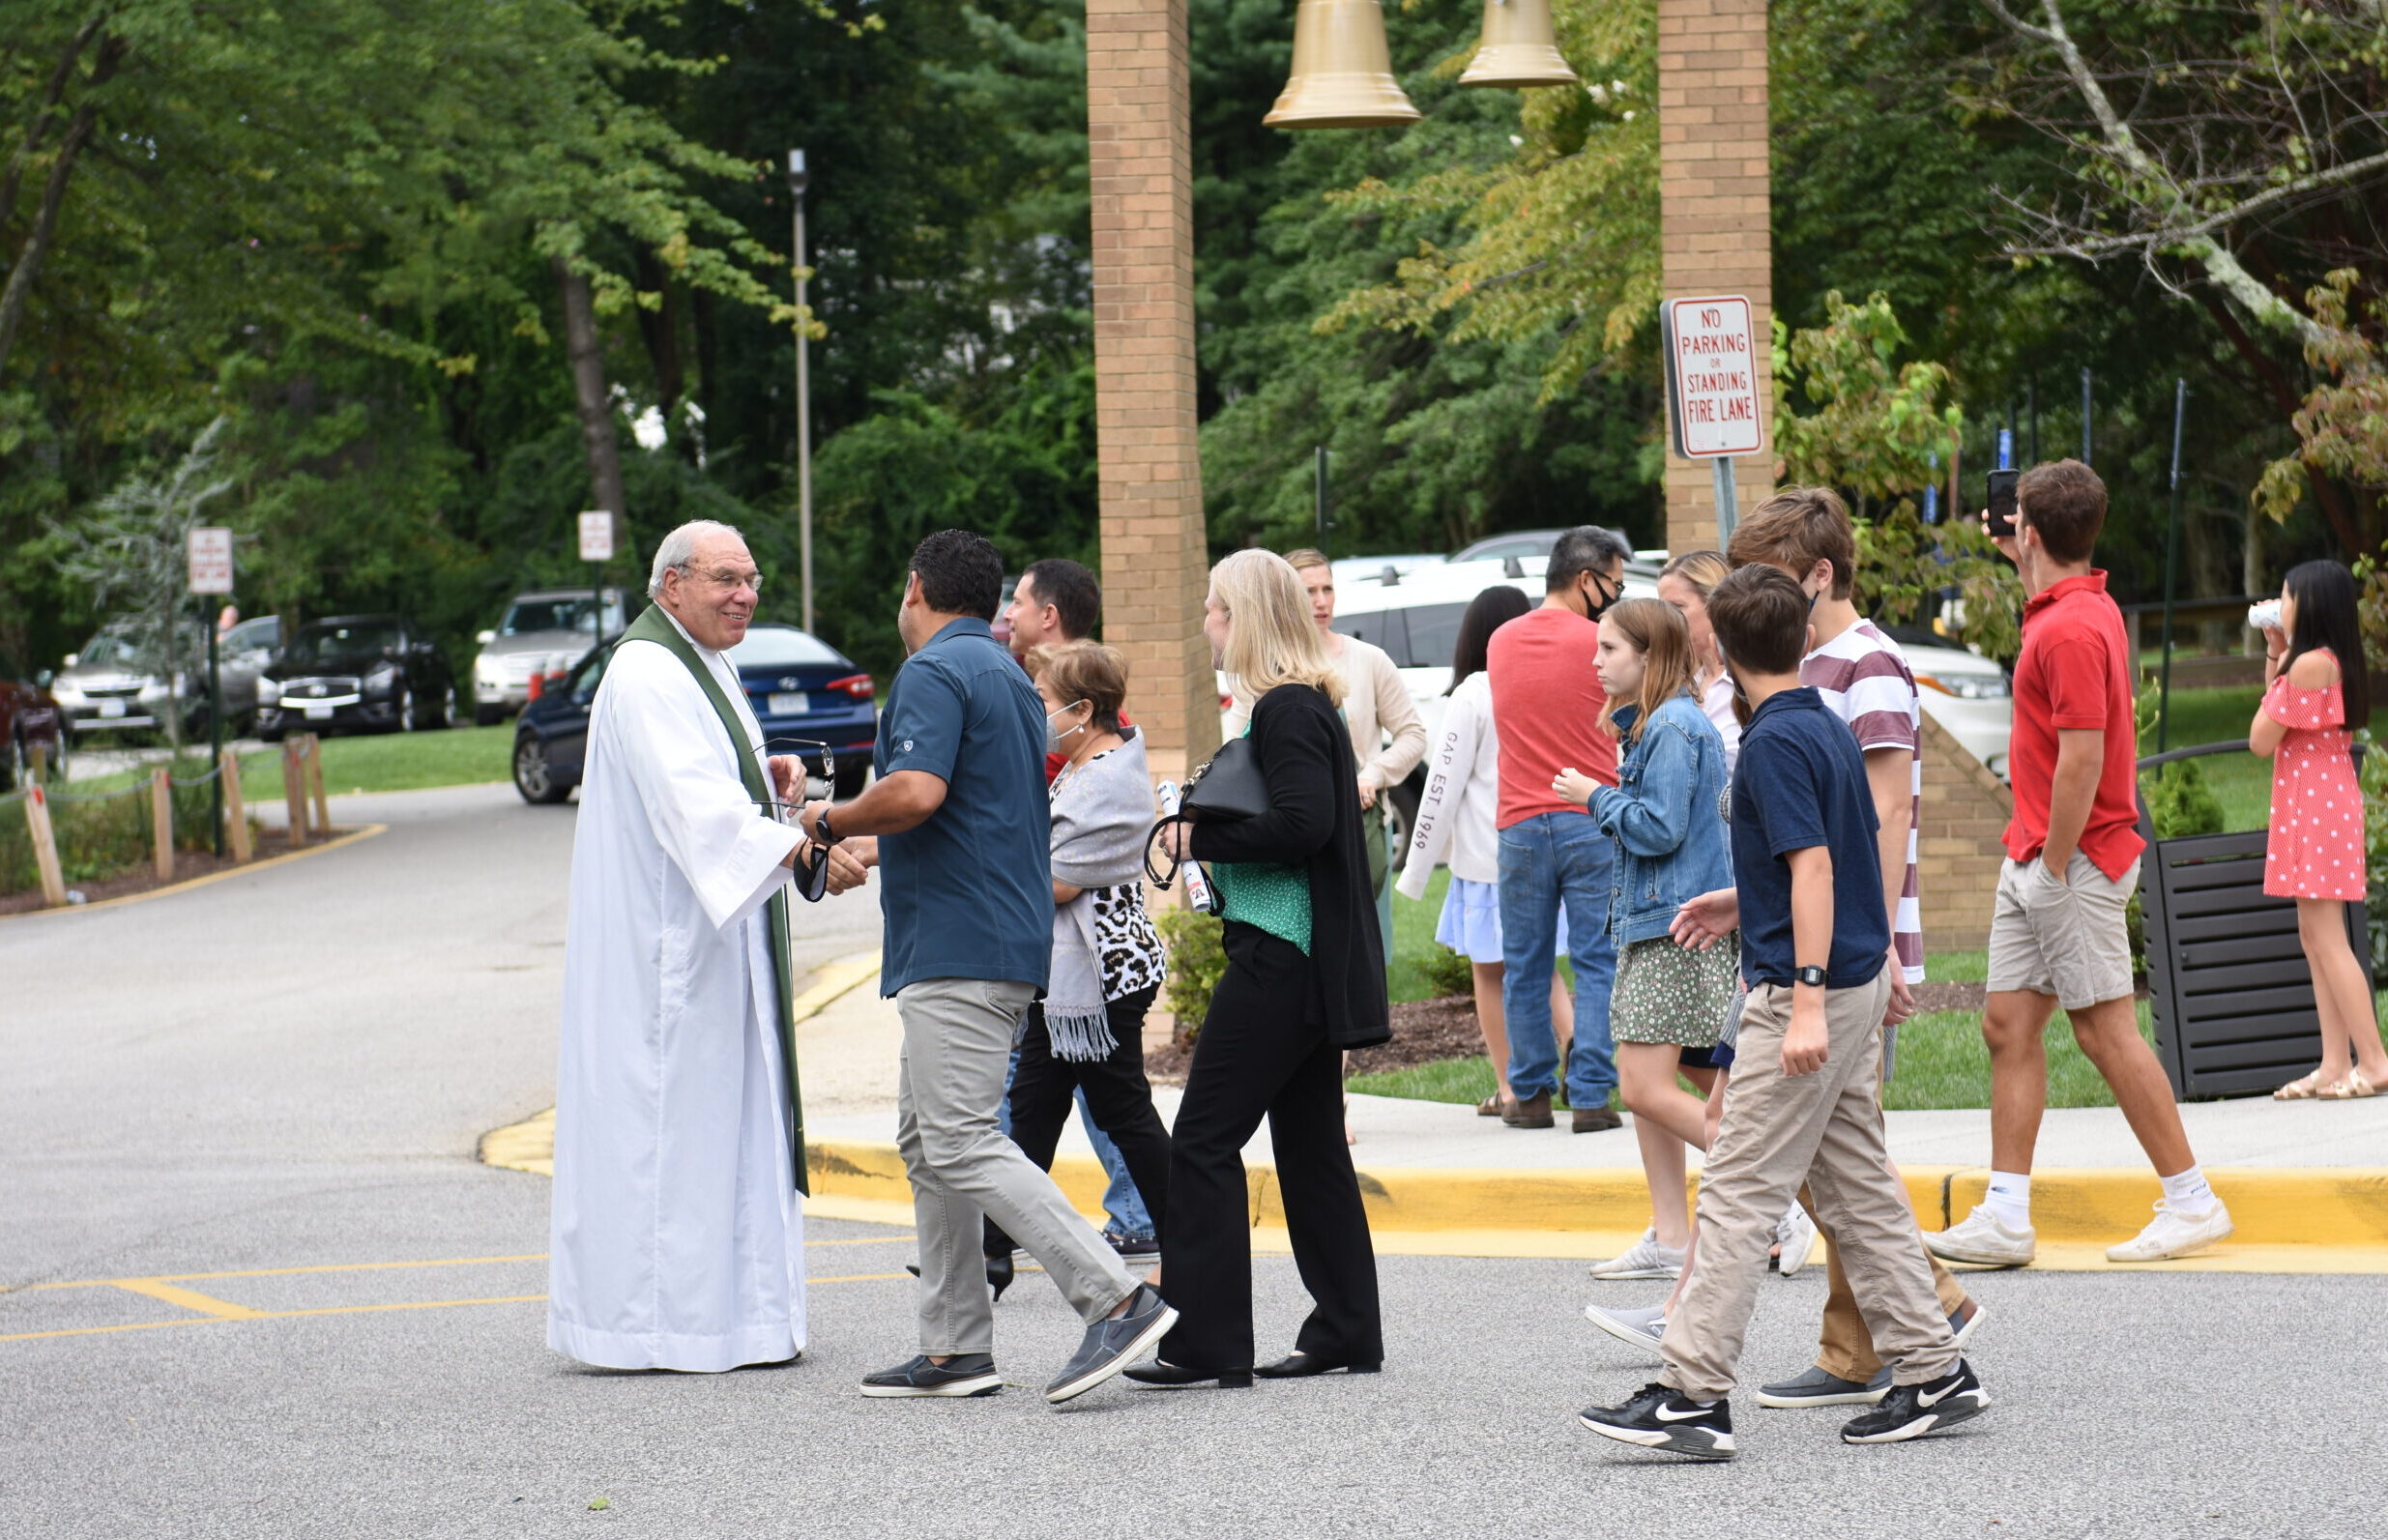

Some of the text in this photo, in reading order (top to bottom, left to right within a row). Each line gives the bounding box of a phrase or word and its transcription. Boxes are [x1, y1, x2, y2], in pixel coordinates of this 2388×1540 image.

[1701, 308, 1721, 328] NO
[1682, 333, 1745, 356] PARKING
[1709, 358, 1721, 368] OR
[1688, 371, 1747, 393] STANDING
[1688, 396, 1753, 423] FIRE LANE
[1415, 732, 1458, 850] GAP EST. 1969
